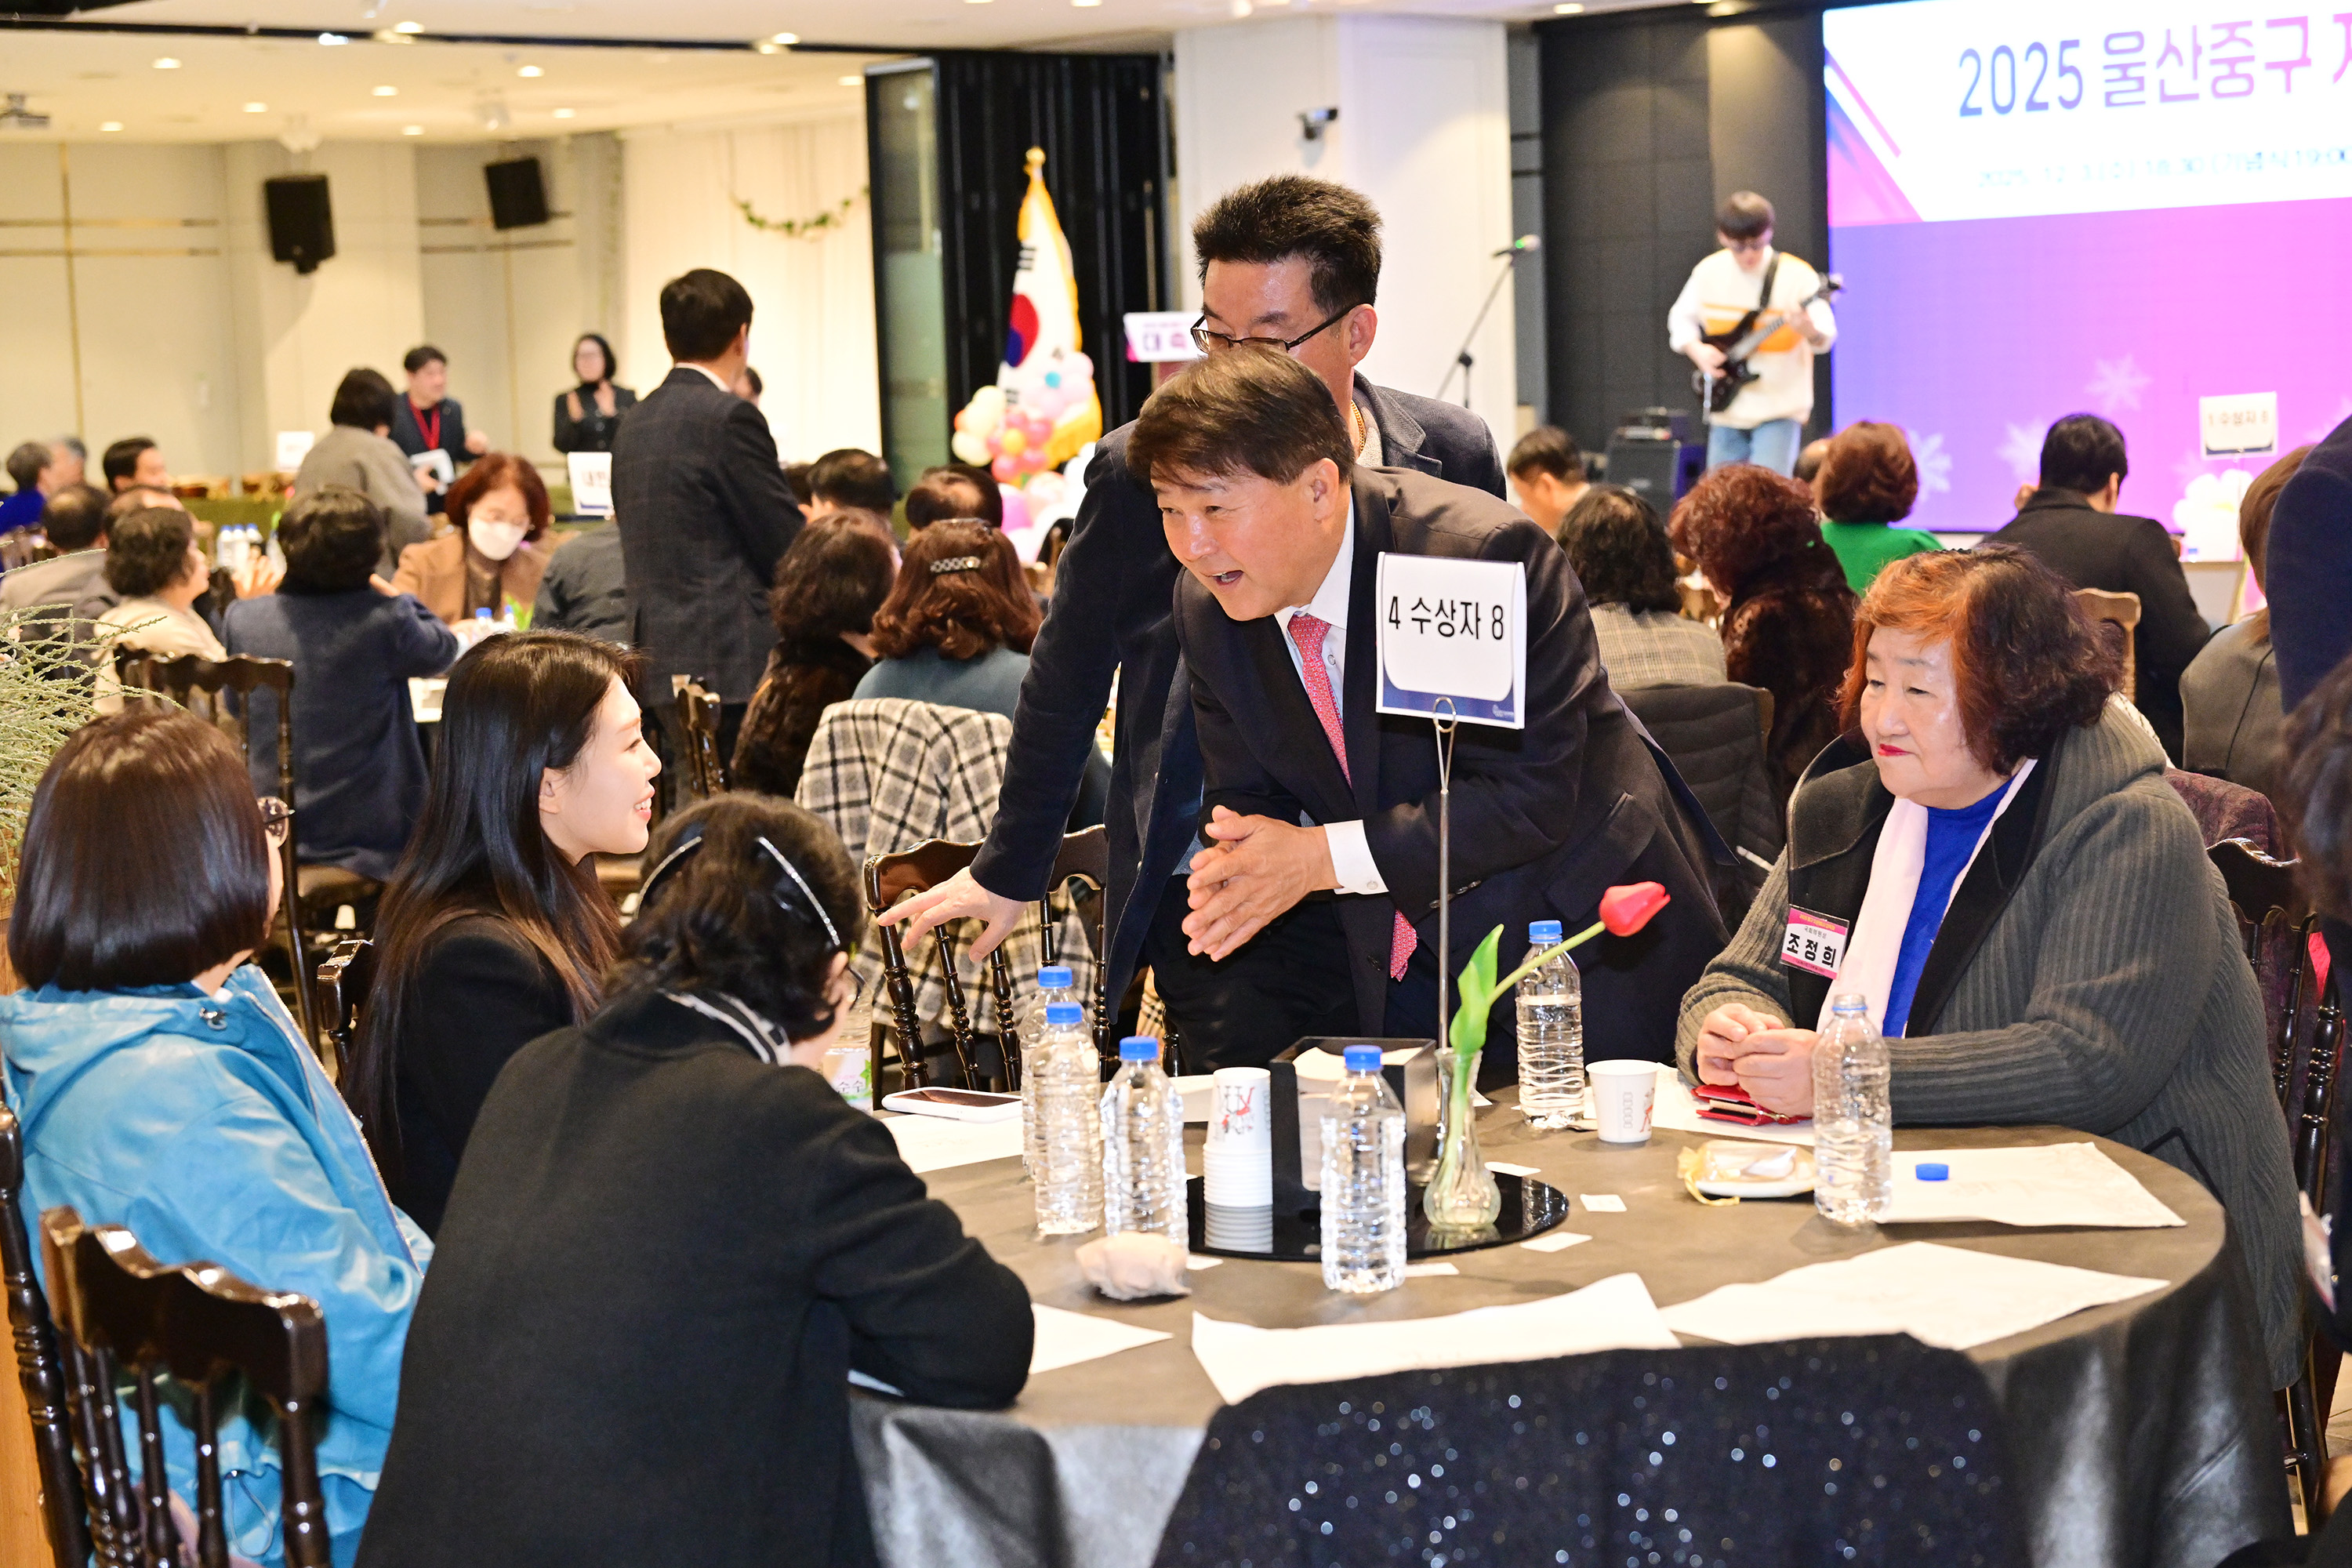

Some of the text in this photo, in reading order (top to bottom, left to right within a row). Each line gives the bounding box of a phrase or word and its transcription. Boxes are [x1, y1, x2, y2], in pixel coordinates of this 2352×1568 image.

[1959, 39, 2083, 117] 2025
[2103, 16, 2312, 108] 울산중구
[1388, 596, 1504, 641] 4 수상자 8
